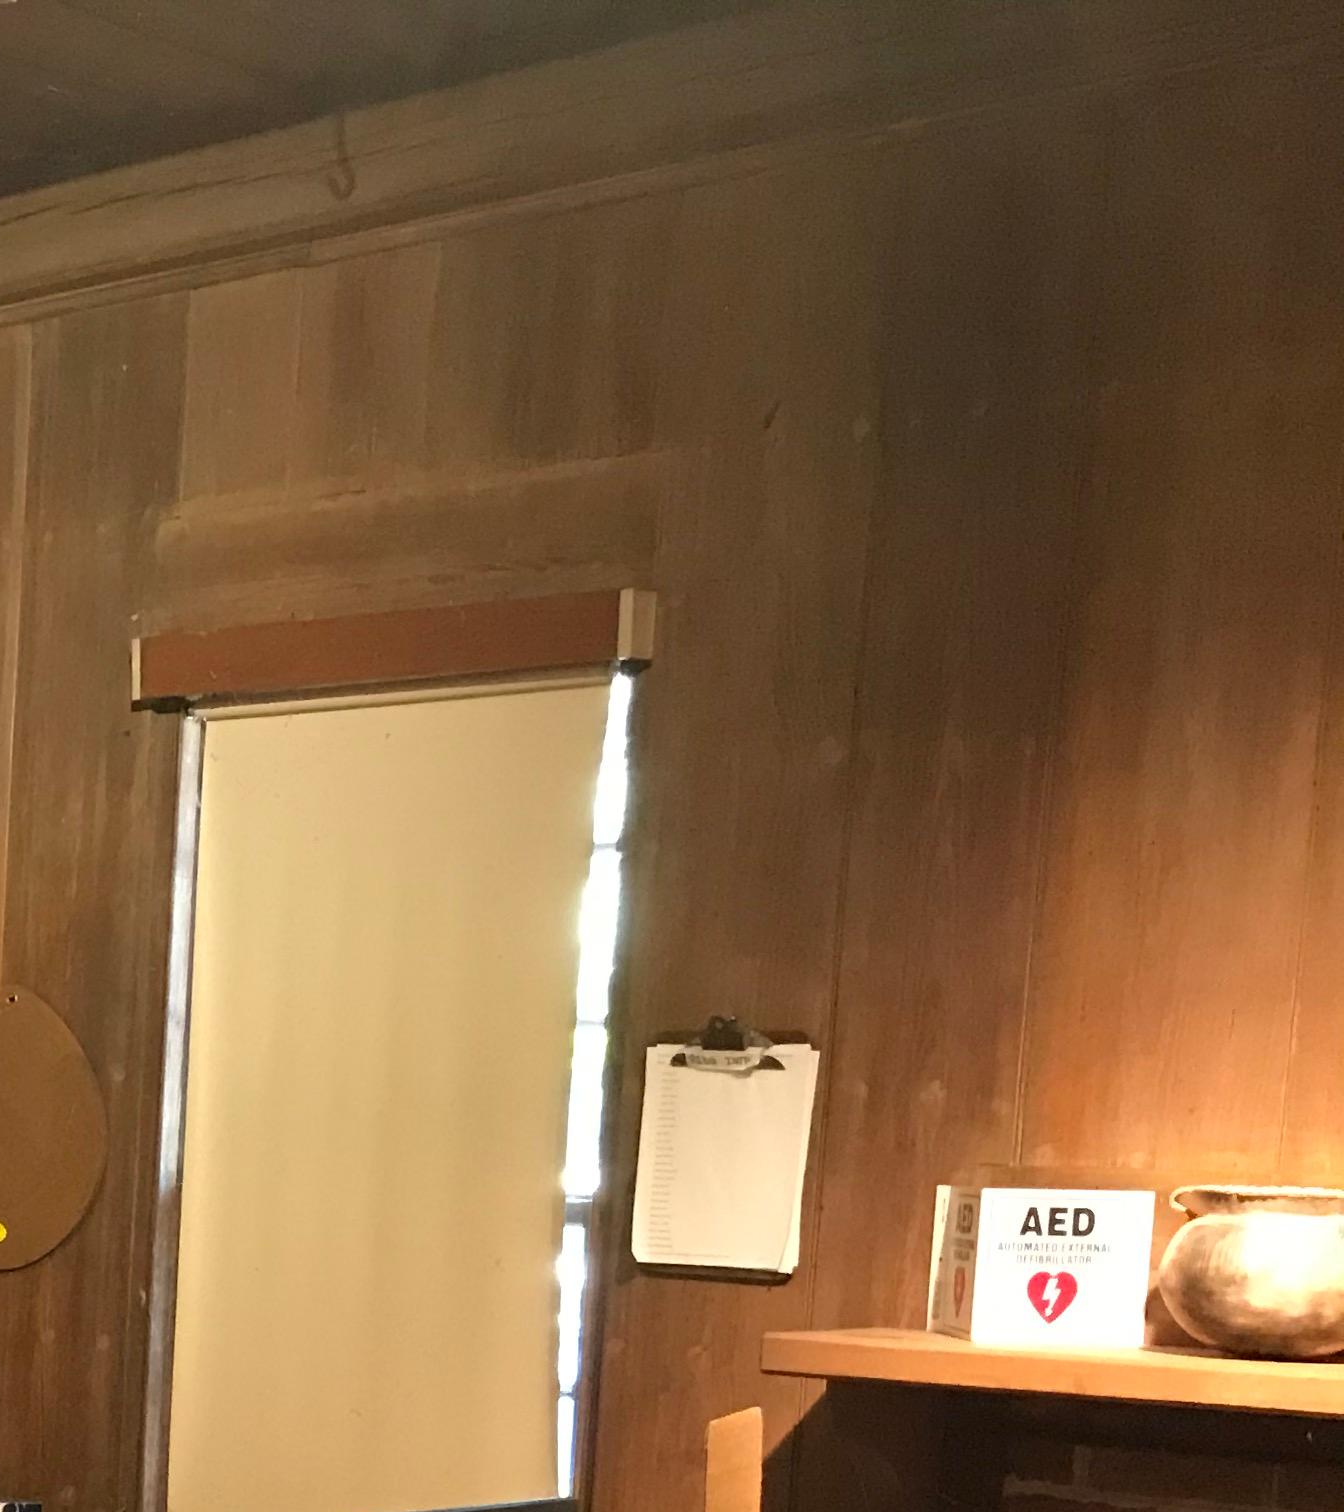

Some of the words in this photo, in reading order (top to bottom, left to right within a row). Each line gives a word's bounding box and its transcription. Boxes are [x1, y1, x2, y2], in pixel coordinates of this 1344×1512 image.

[1020, 1206, 1096, 1237] AED
[998, 1242, 1058, 1252] AUTOMATED
[1062, 1243, 1112, 1253] EXTERNAL
[1016, 1255, 1092, 1264] DEFIBRILLATOR
